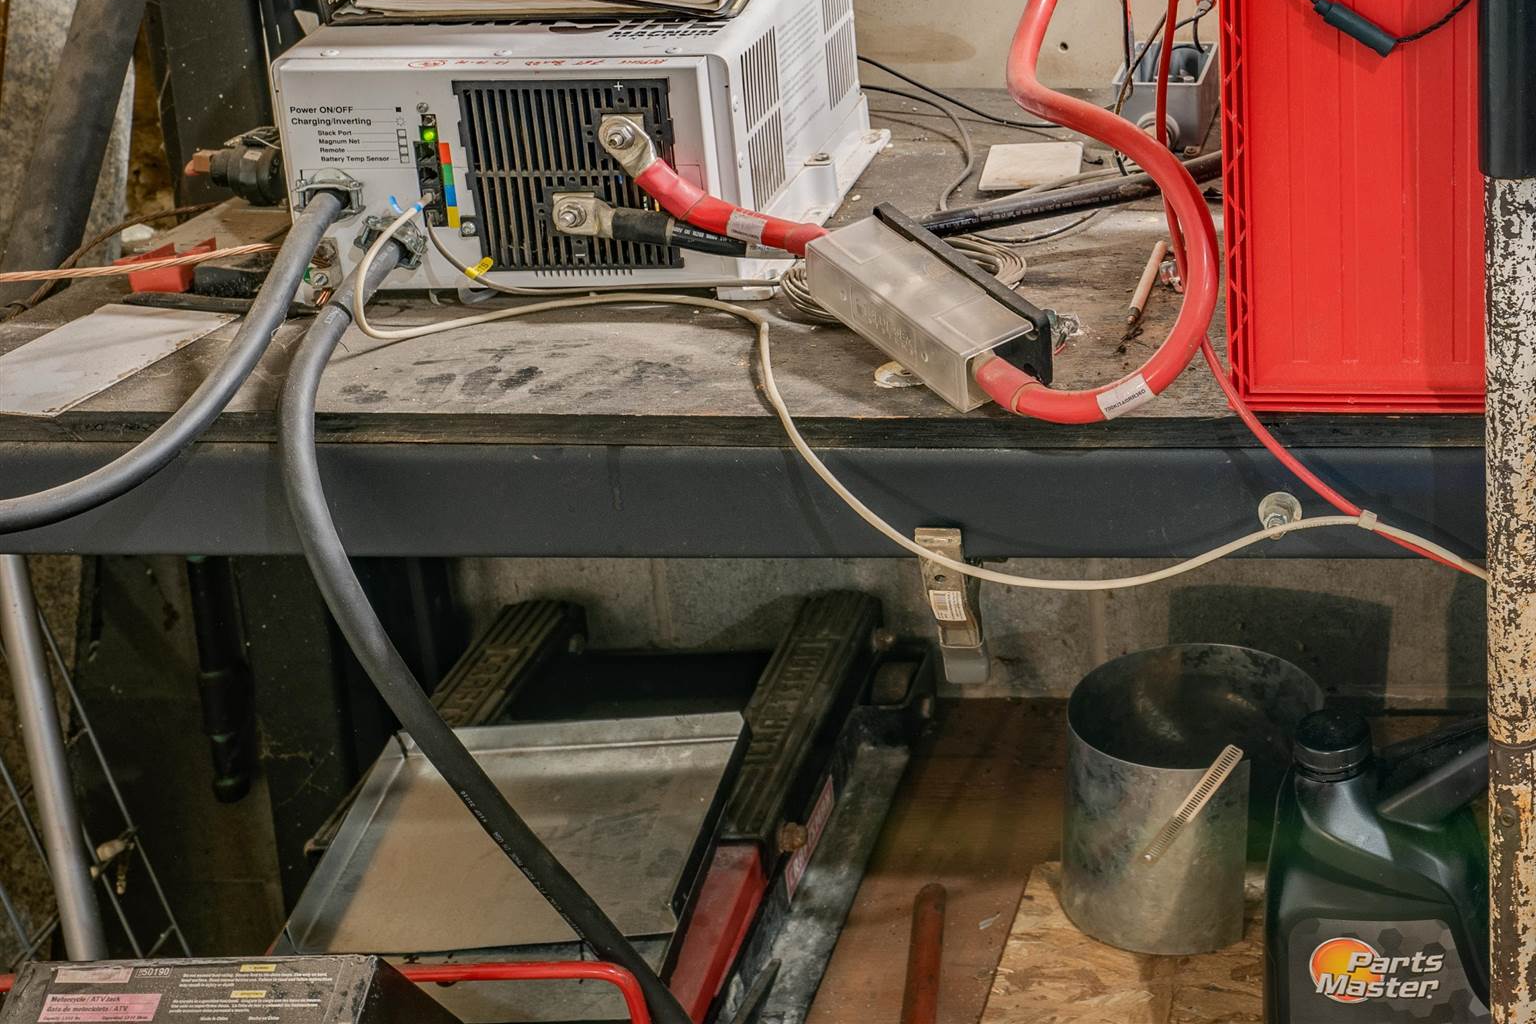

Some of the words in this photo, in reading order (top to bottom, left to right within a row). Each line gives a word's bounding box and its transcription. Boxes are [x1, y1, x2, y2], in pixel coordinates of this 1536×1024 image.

[607, 29, 719, 38] MAGNUM
[290, 106, 317, 114] Power
[319, 106, 354, 114] ON/OFF
[291, 117, 372, 126] Charging/Inverting
[1347, 951, 1445, 974] Parts
[141, 967, 170, 976] 50190
